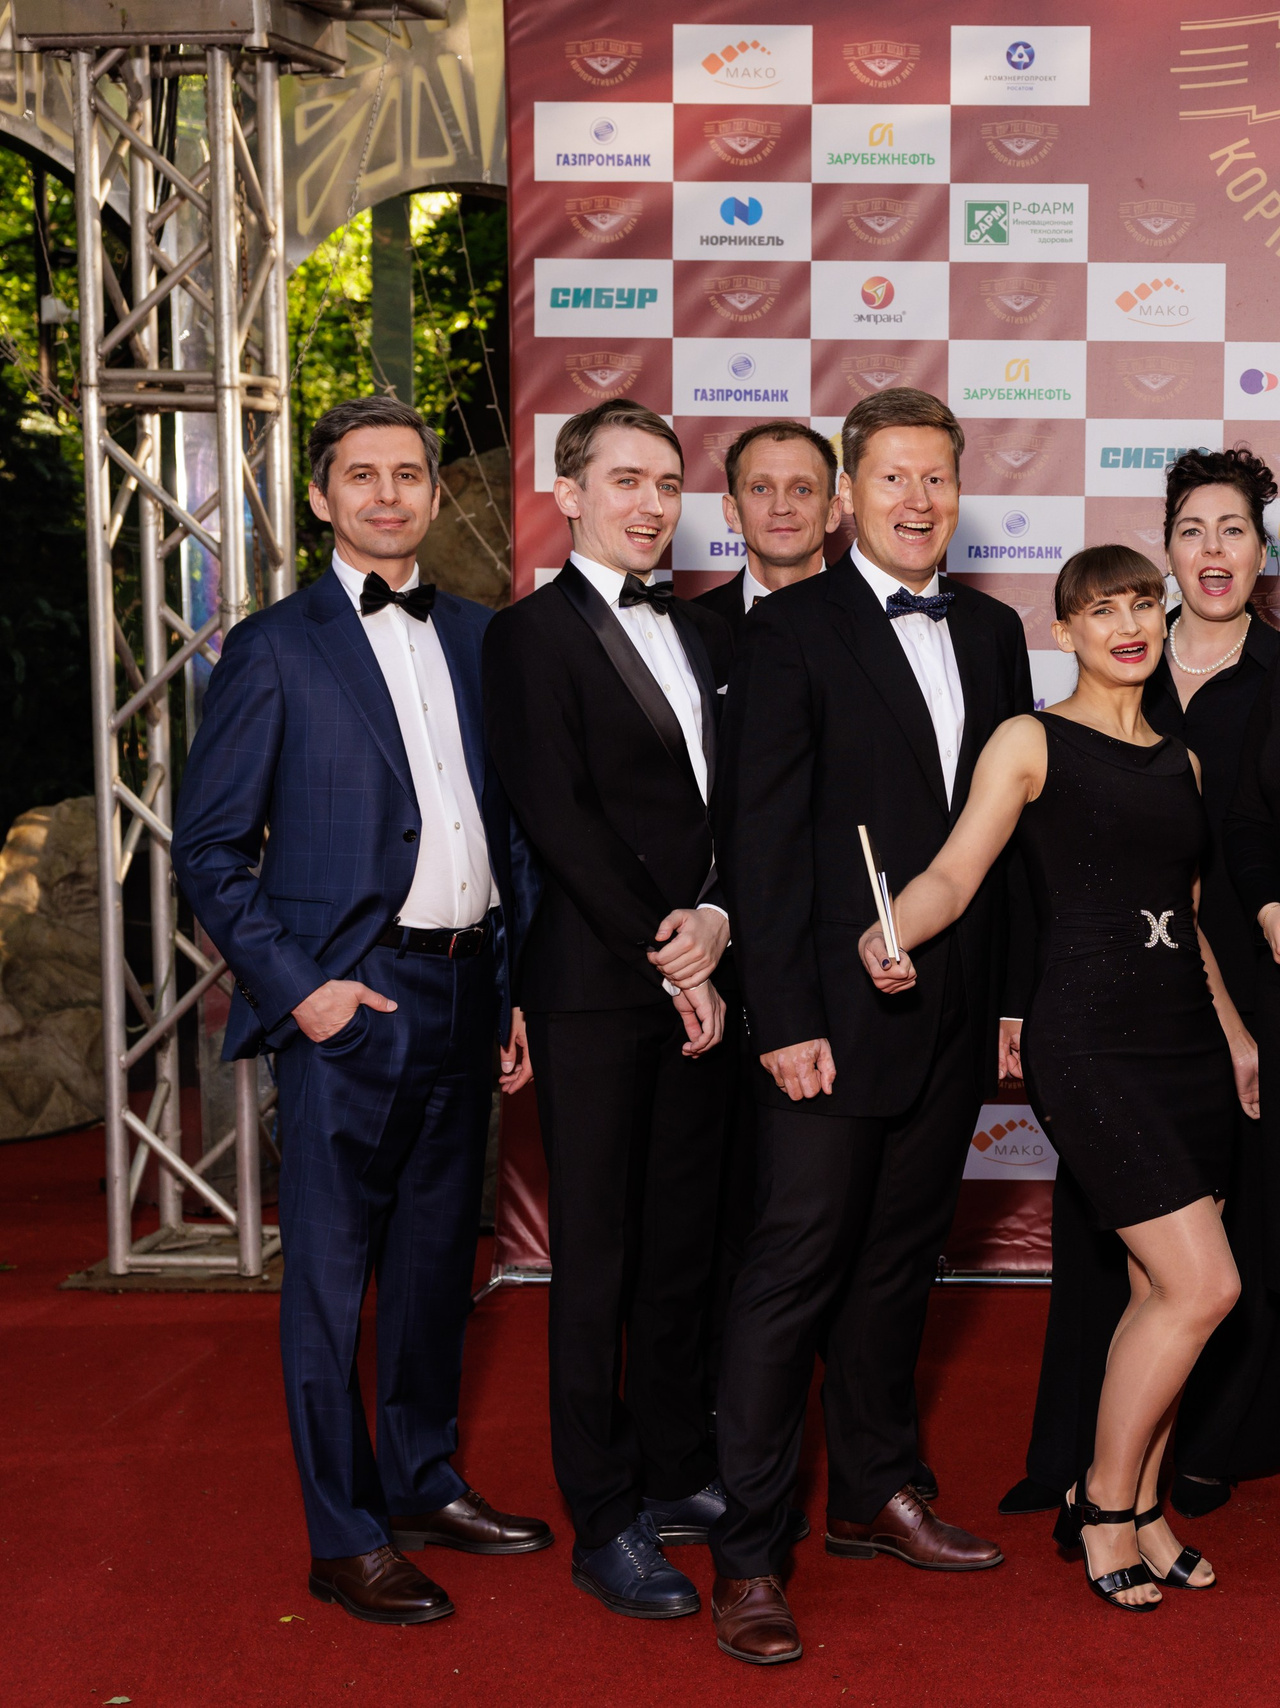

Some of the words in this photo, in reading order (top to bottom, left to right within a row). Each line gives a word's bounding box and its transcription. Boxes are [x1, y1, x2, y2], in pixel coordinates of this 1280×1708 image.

[556, 153, 651, 167] ГАЗПРОМБАНК
[826, 152, 936, 166] ЗАРУБЕЖНЕФТЬ
[1012, 202, 1074, 215] Р-ФАРМ
[1012, 218, 1073, 227] Инновационные
[1030, 228, 1073, 236] технологии
[700, 235, 784, 246] НОРНИКЕЛЬ
[1038, 236, 1073, 244] здоровья
[550, 288, 658, 309] СИБУР
[694, 388, 788, 402] ГАЗПРОМБАНК
[963, 388, 1072, 401] ЗАРУБЕЖНЕФТЬ
[968, 545, 1063, 560] ГАЗПРОМБАНК
